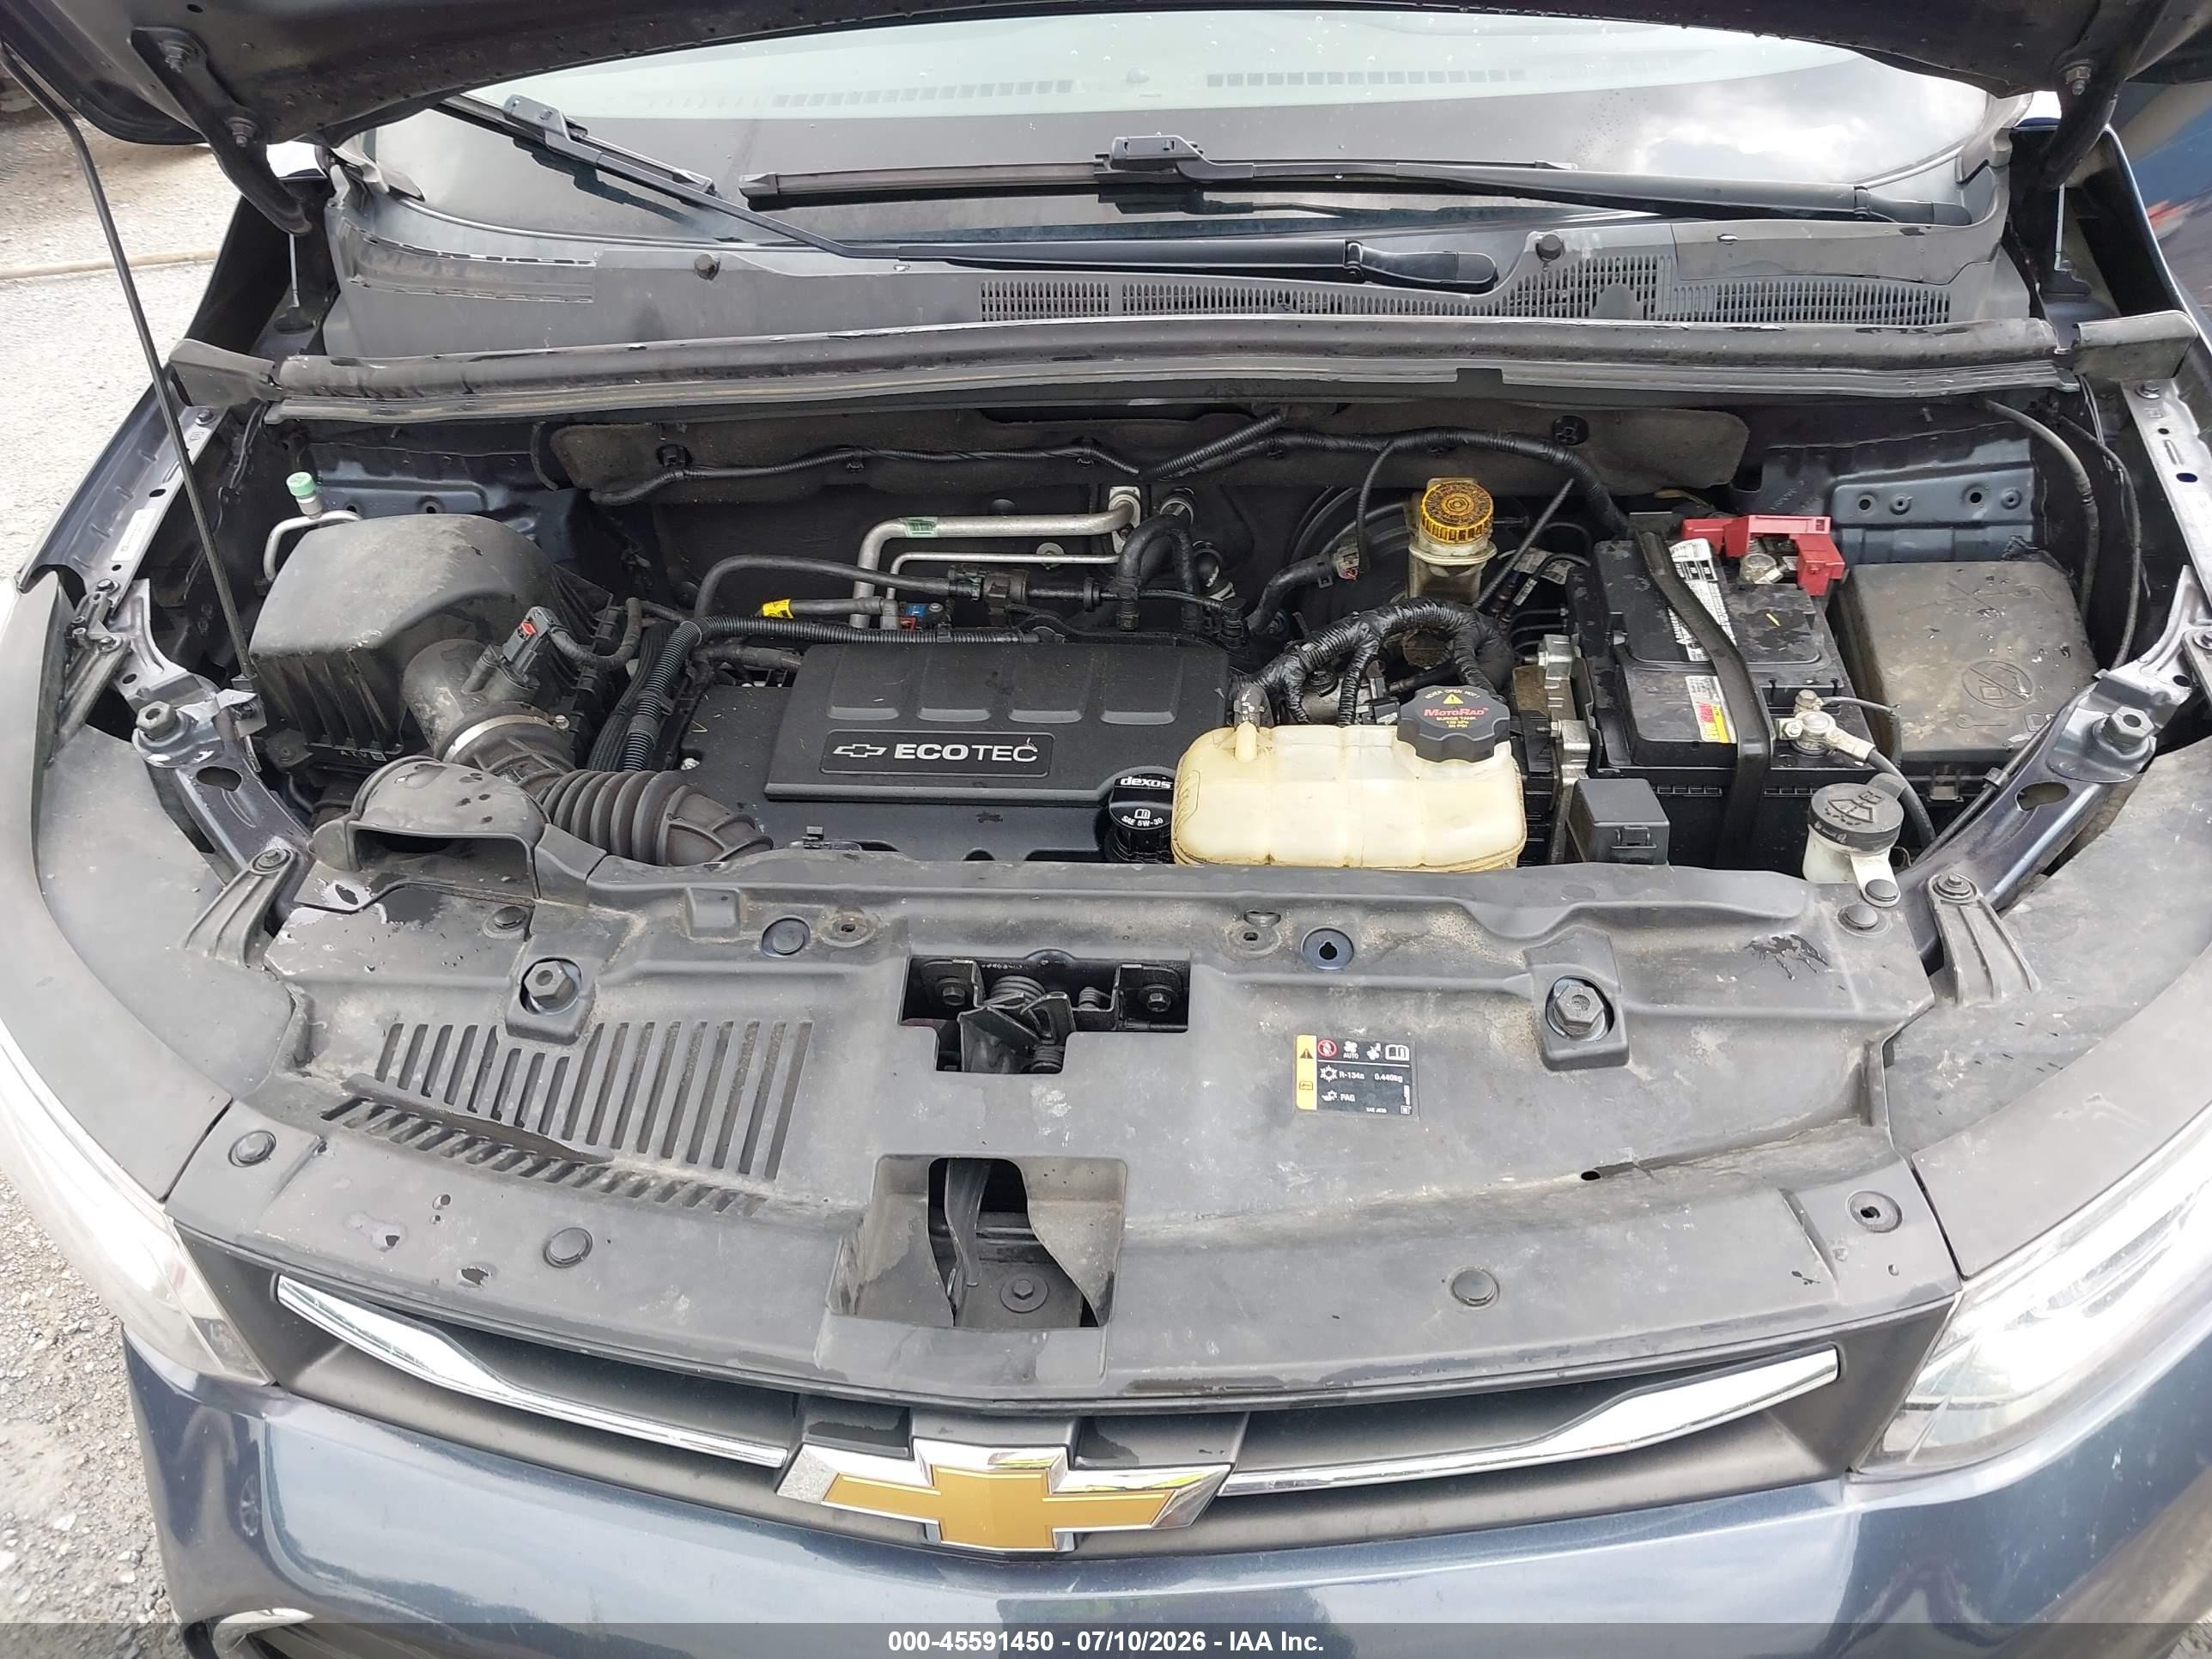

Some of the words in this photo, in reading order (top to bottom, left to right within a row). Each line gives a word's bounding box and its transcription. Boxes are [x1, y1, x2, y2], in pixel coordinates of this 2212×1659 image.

[894, 743, 1038, 763] ECOTEC
[1120, 776, 1173, 789] dexos
[1121, 815, 1135, 826] SAE
[1137, 817, 1163, 827] 5W-30
[1339, 1071, 1365, 1079] R-134a
[1340, 1094, 1355, 1102] PAG
